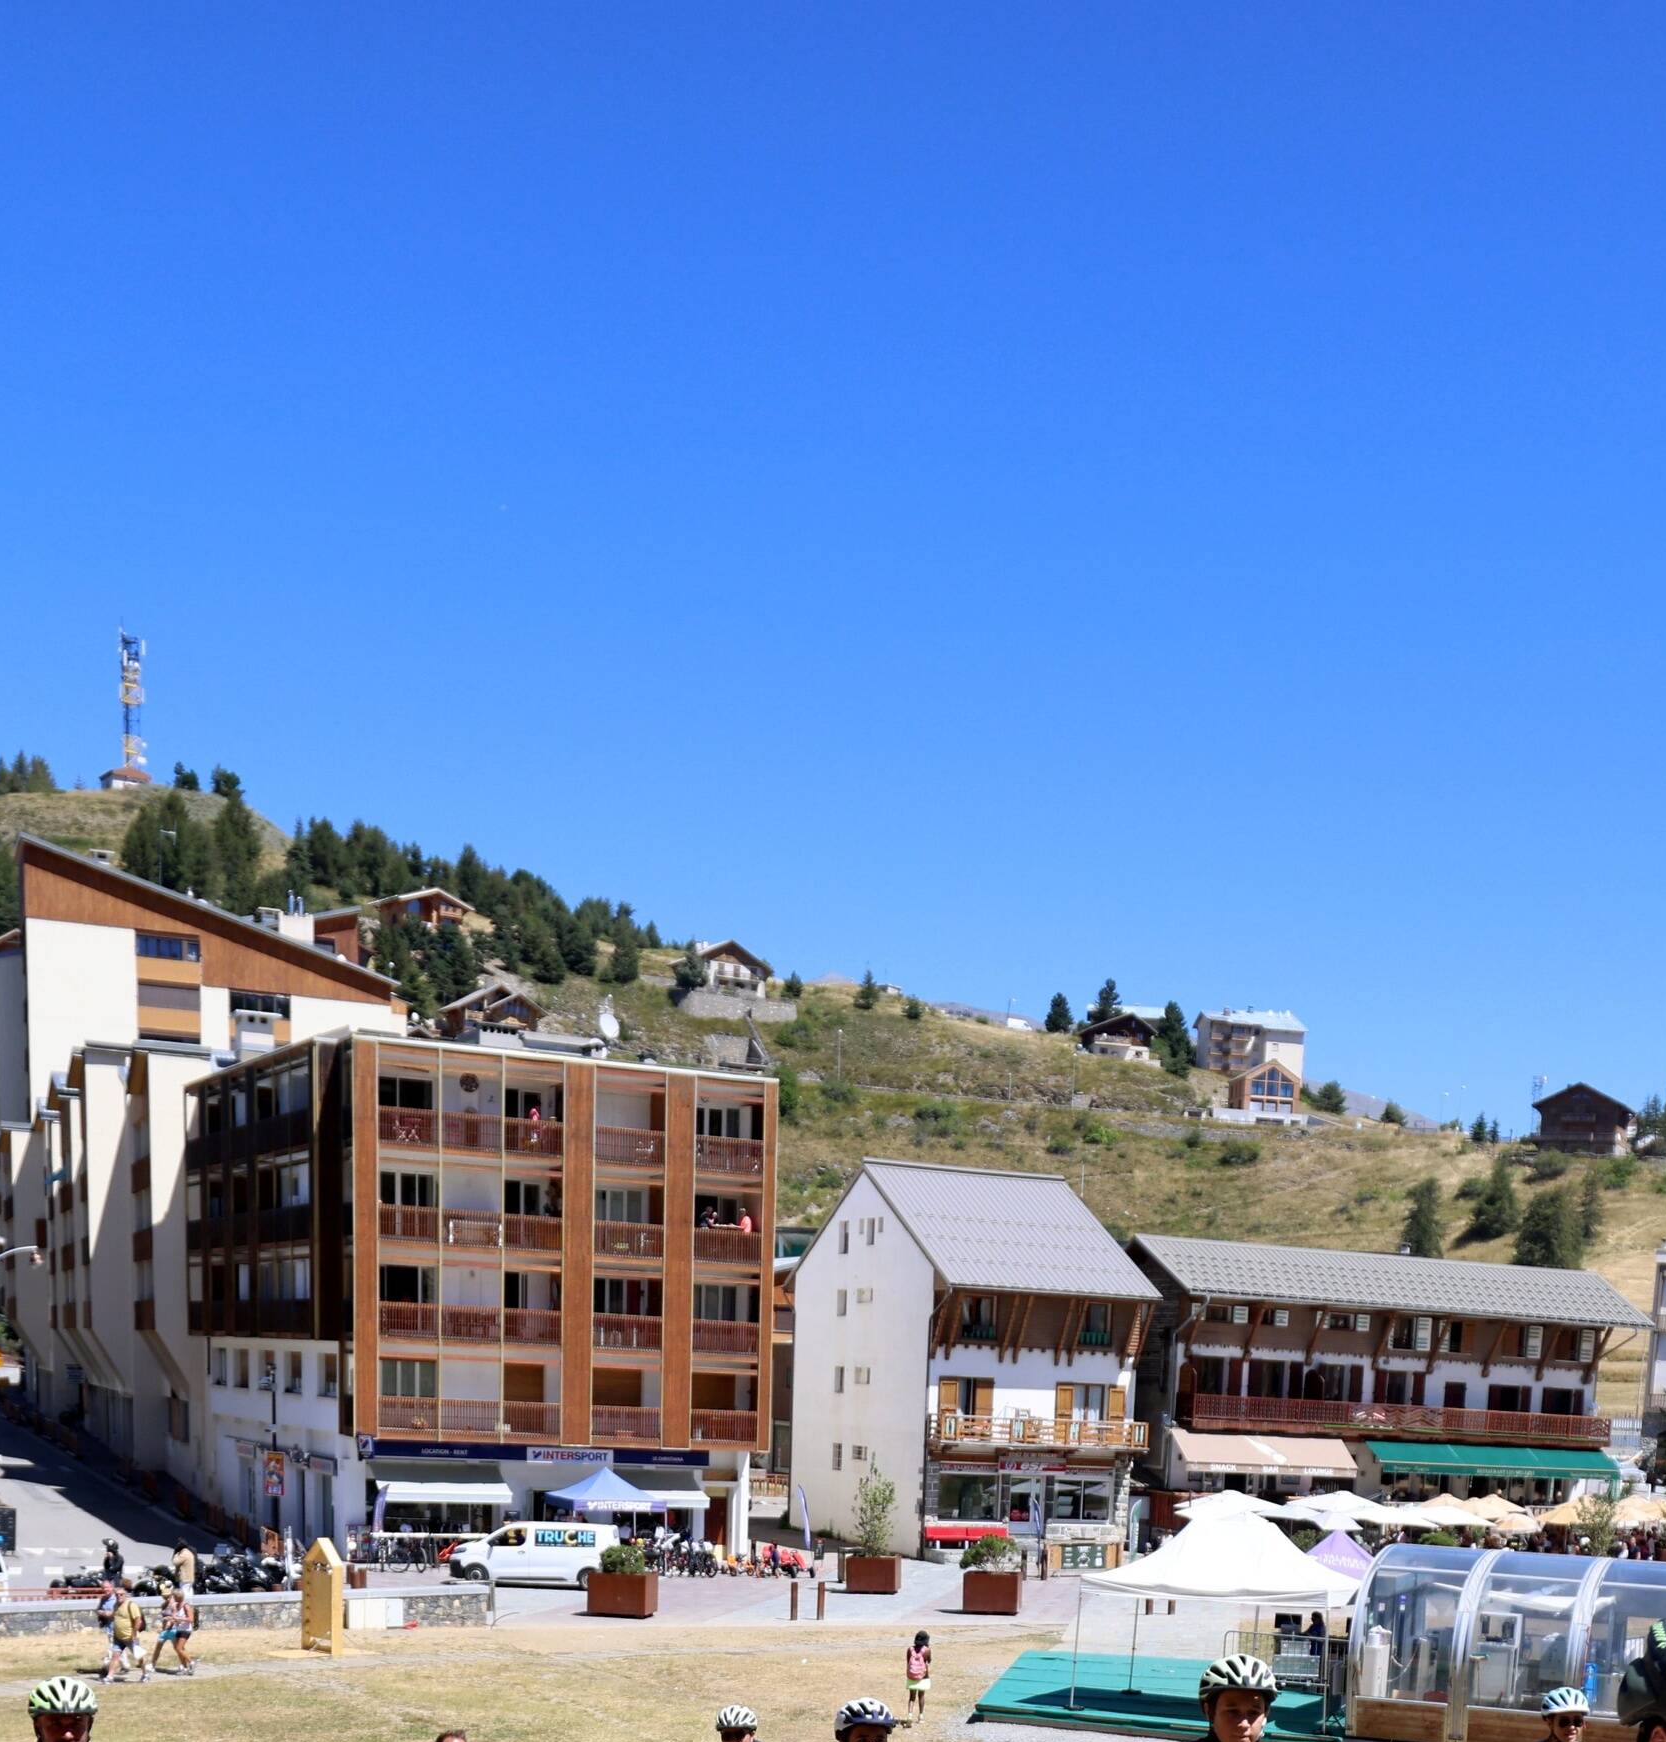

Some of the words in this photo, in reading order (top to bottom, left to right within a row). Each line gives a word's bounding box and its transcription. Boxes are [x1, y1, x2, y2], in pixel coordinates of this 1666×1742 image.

[542, 1450, 609, 1462] INTERSPORT
[1210, 1463, 1237, 1472] SNACK
[1303, 1467, 1334, 1475] LOUNGE
[596, 1501, 653, 1511] INTERSPORT
[536, 1529, 595, 1545] TRUCHE
